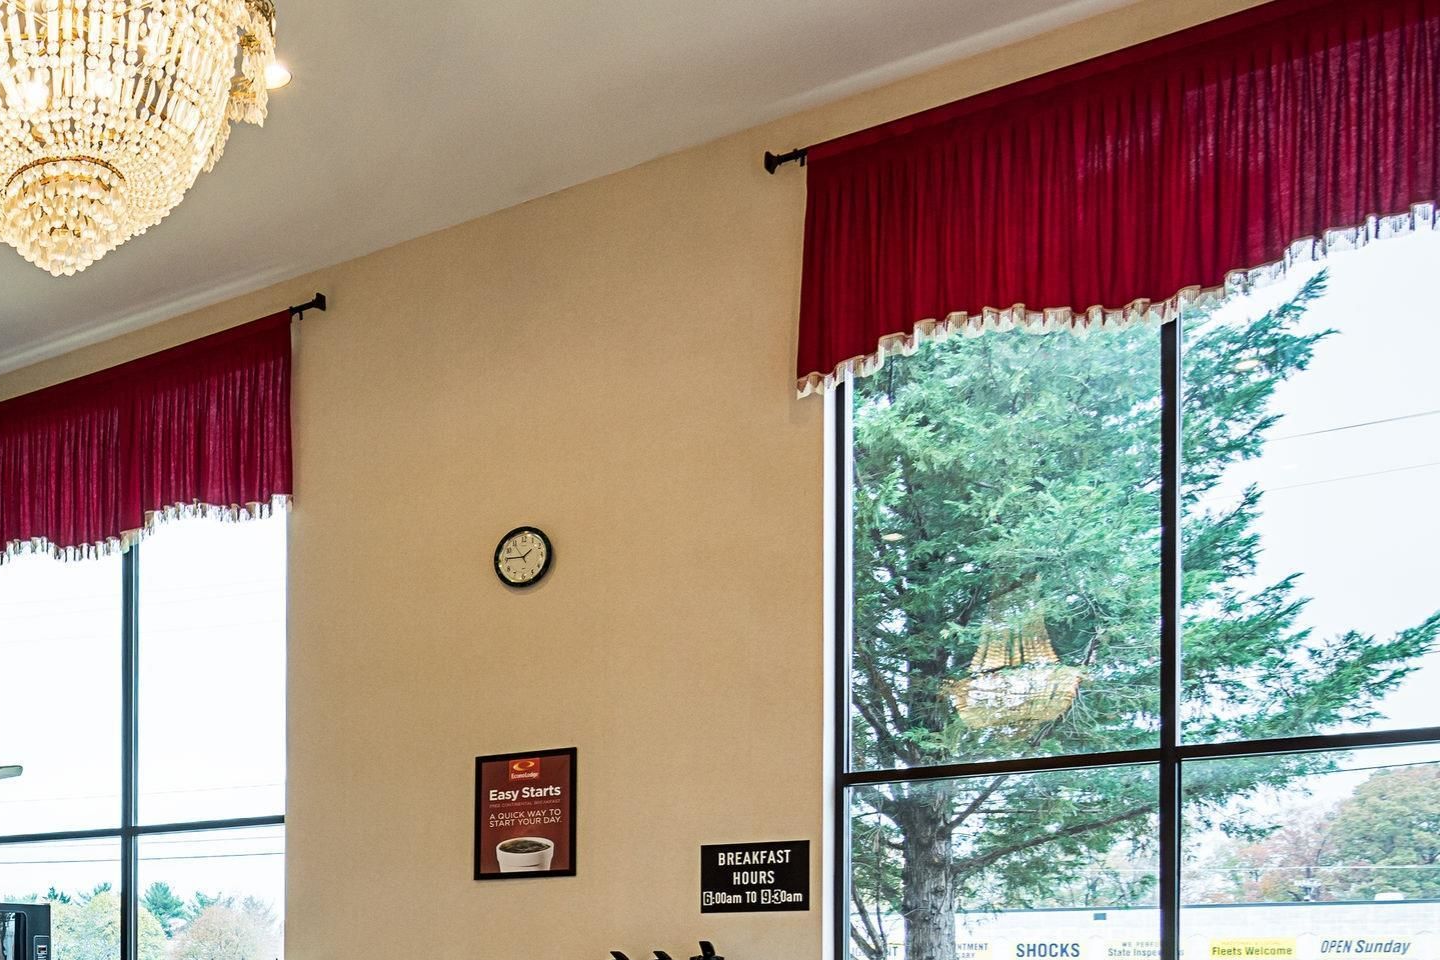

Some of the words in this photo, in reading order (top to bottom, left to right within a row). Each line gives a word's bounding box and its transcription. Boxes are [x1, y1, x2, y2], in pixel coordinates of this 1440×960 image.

[489, 789, 519, 801] Easy
[521, 785, 561, 798] Starts
[497, 811, 525, 820] QUICK
[526, 809, 547, 817] WAY
[549, 808, 562, 816] TO
[489, 819, 515, 828] START
[517, 817, 541, 826] YOUR
[718, 849, 791, 866] BREAKFAST
[732, 870, 775, 886] HOURS
[702, 890, 742, 906] 6:00am
[745, 890, 758, 904] TO
[760, 888, 803, 905] 9:30am
[1016, 942, 1080, 958] SHOCKS
[1107, 947, 1131, 957] State
[1211, 946, 1242, 956] Fleets
[1245, 946, 1293, 956] Welcome
[1320, 939, 1352, 954] OPEN
[1354, 938, 1411, 956] Sunday
